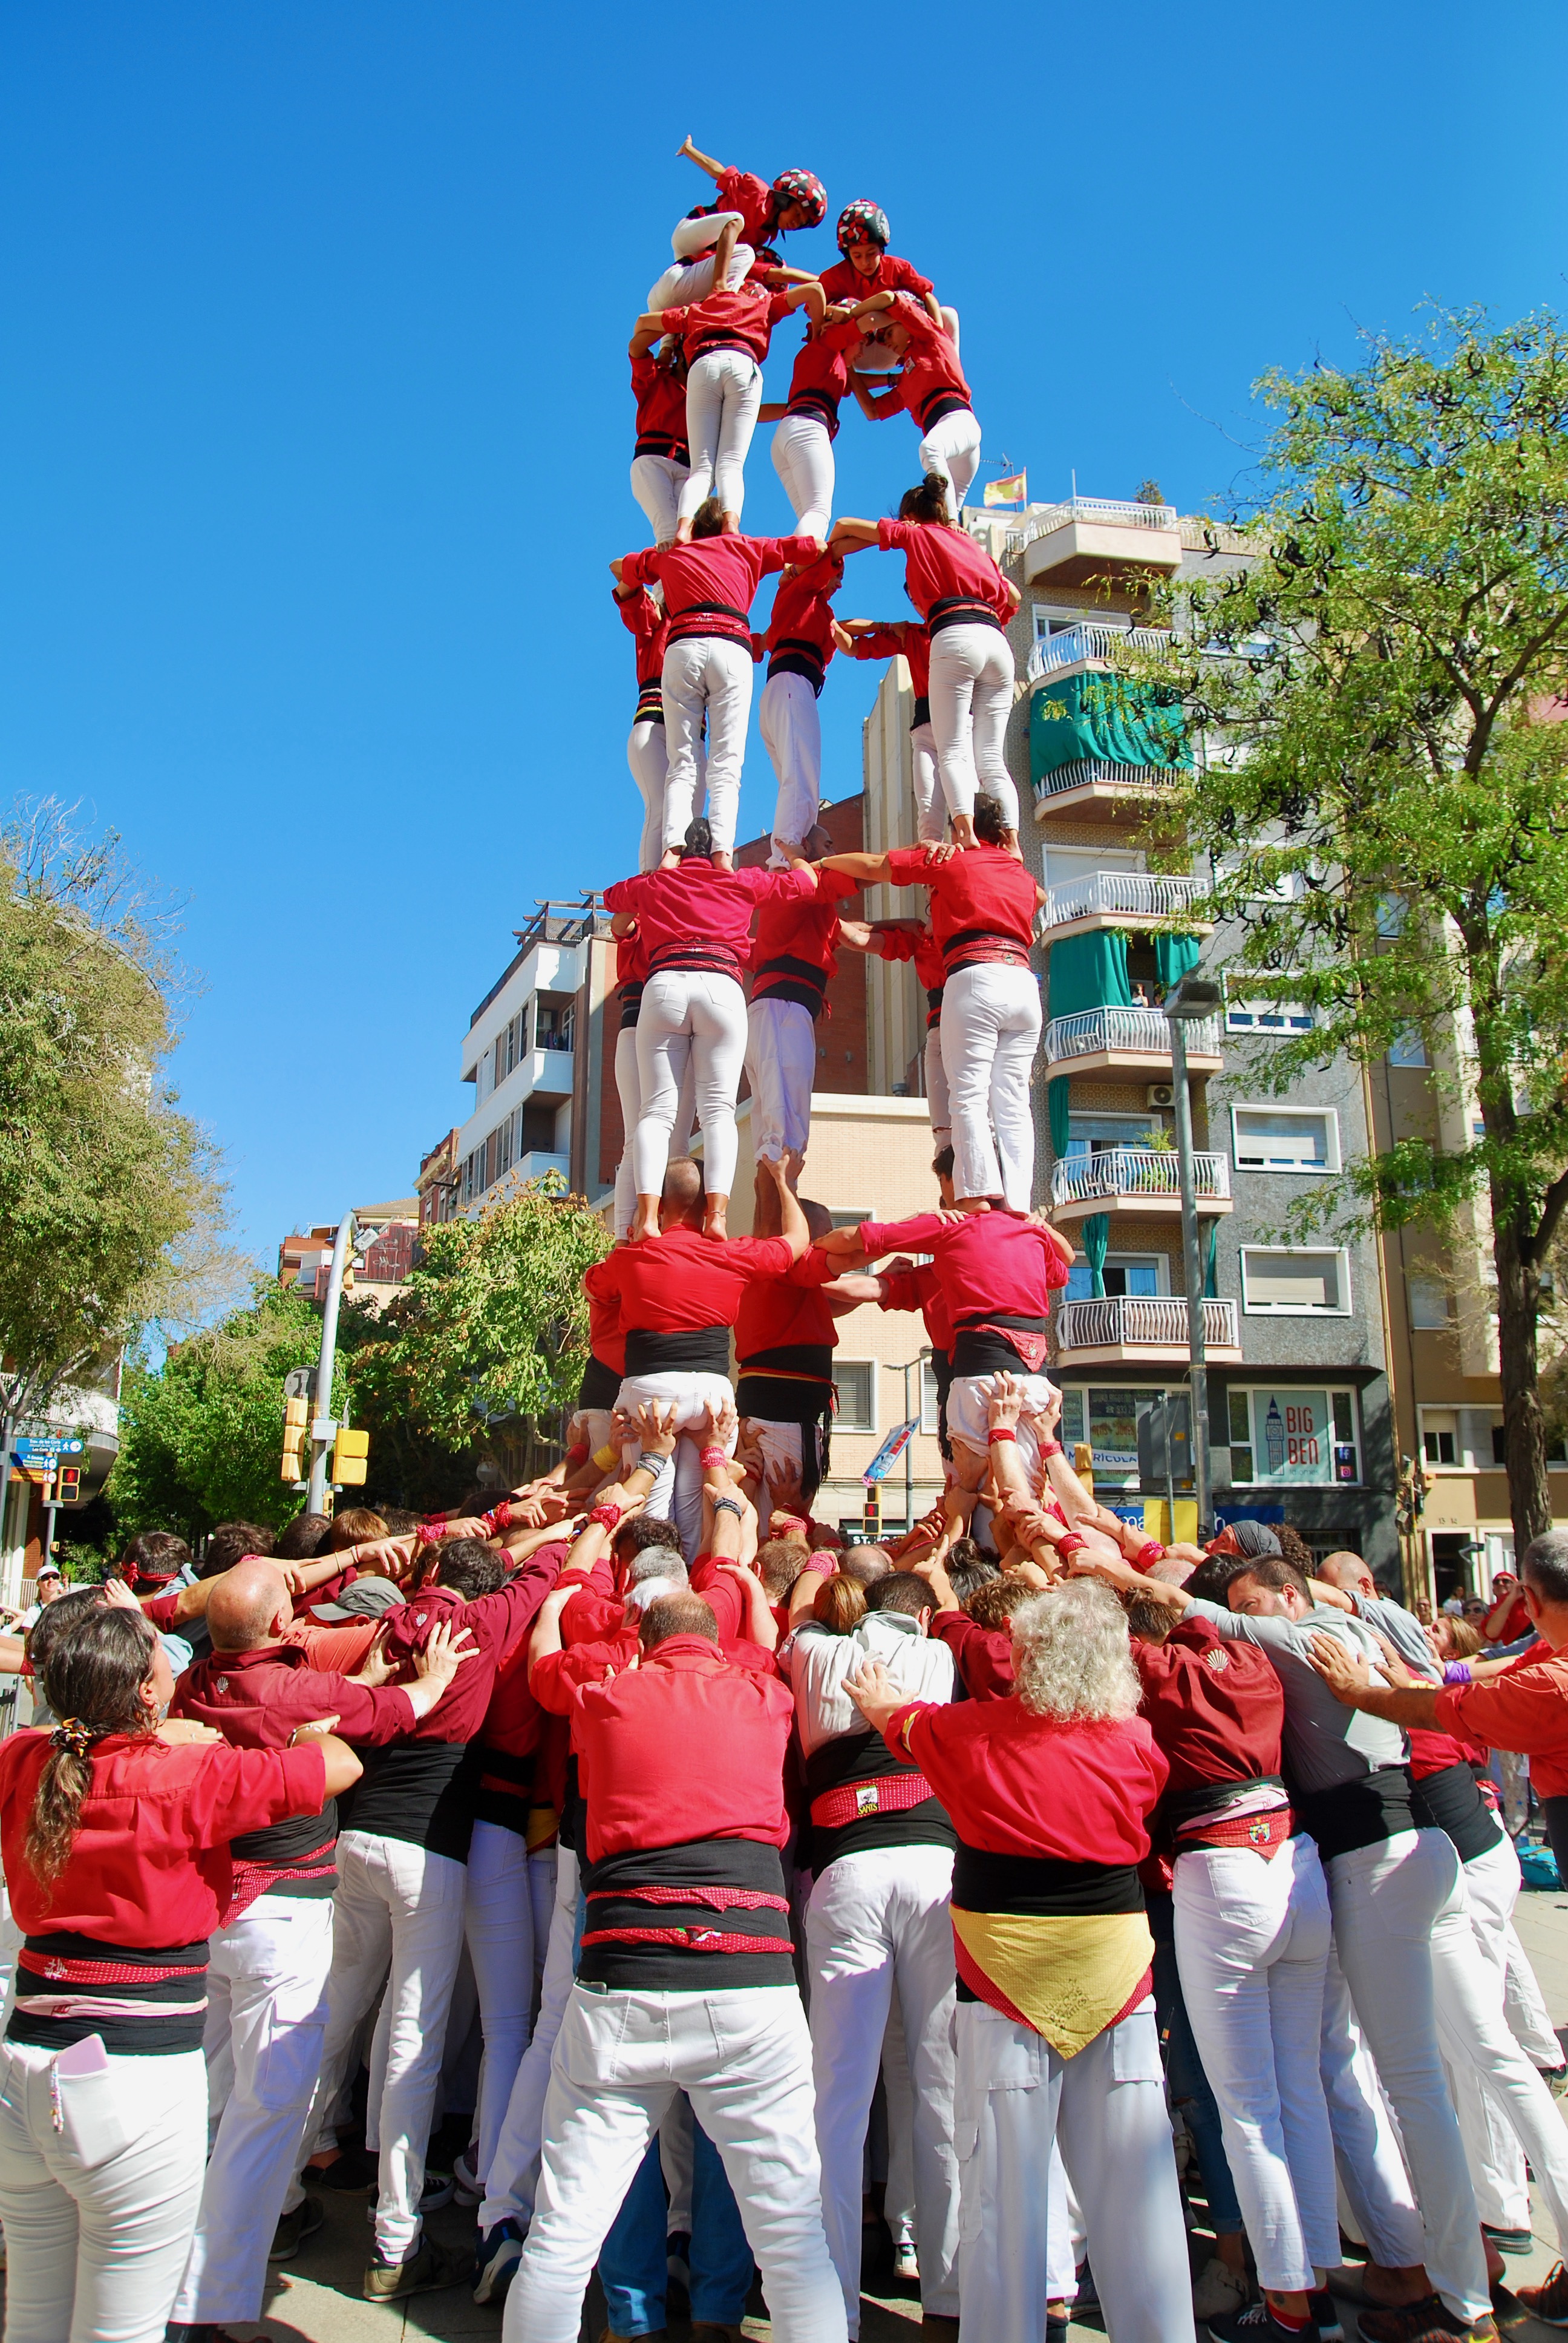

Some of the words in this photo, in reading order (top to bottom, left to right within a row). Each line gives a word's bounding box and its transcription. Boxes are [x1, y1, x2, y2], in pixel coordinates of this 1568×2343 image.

[1286, 1407, 1313, 1433] BIG
[1068, 1451, 1137, 1463] MRÍCULA
[1289, 1438, 1319, 1464] BEN
[853, 1535, 871, 1545] ST.
